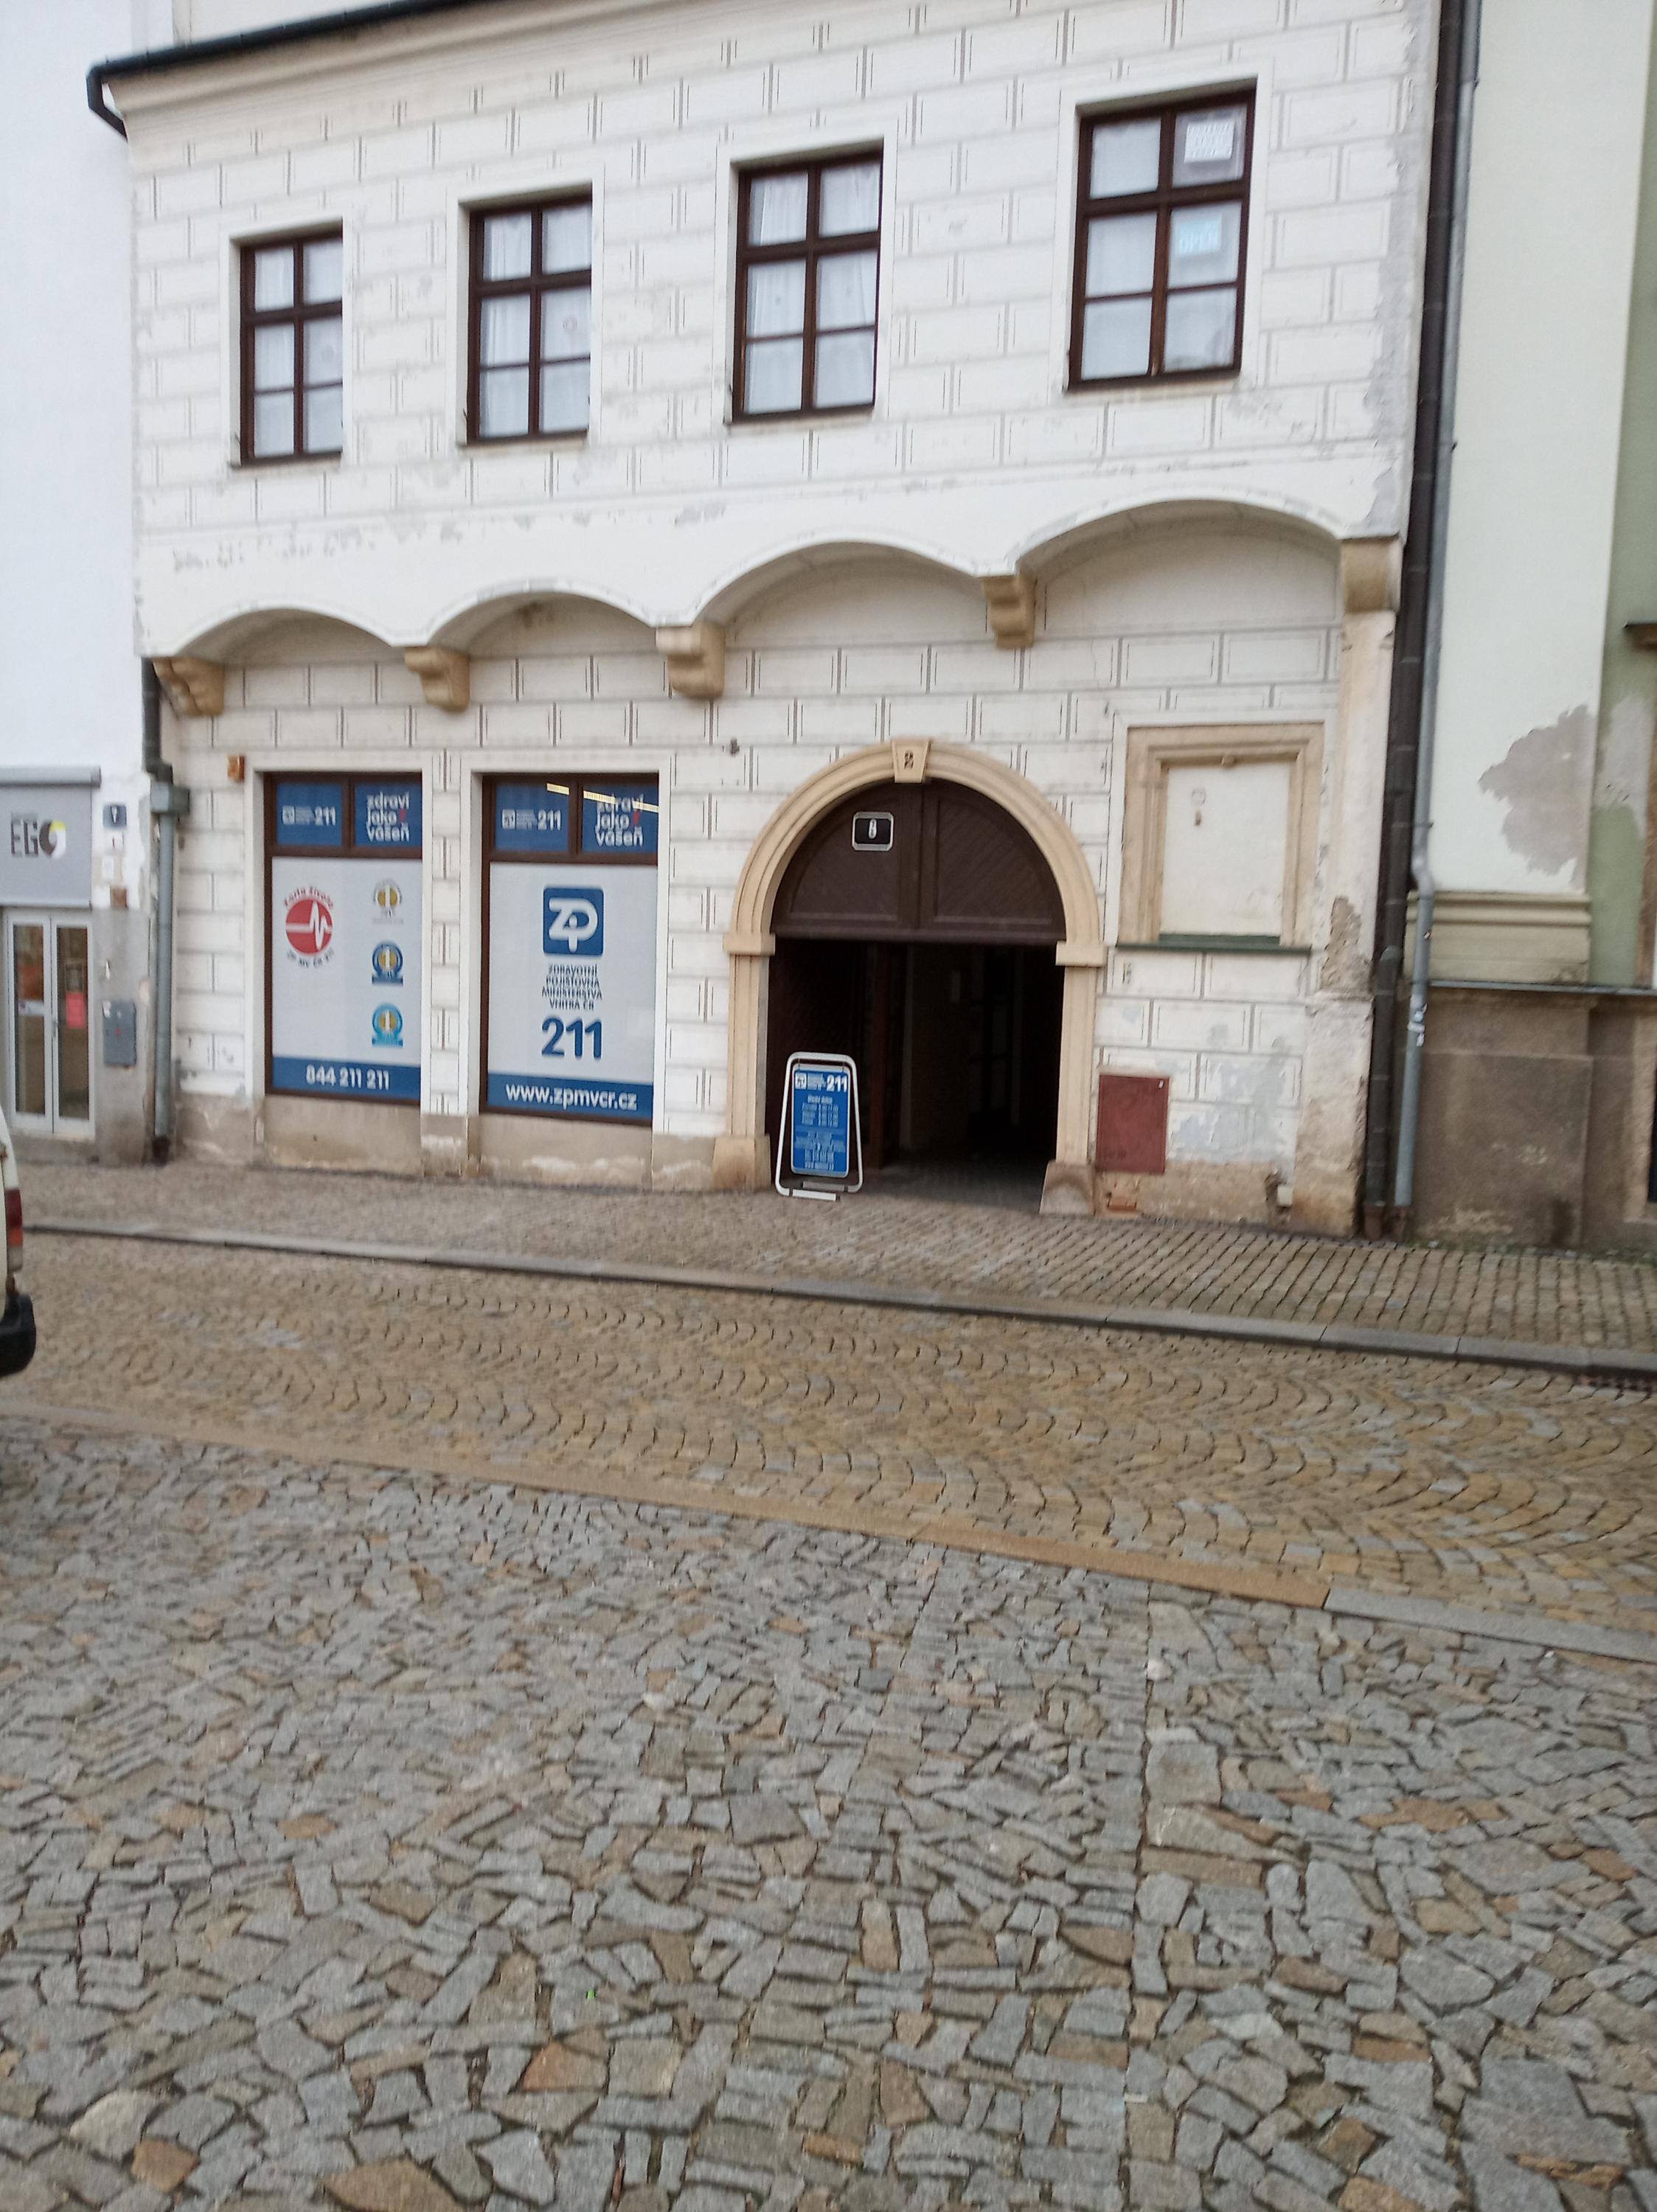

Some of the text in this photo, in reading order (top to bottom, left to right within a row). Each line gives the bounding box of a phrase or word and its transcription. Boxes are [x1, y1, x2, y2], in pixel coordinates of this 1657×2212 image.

[538, 810, 561, 830] 211
[10, 818, 67, 859] EGO
[541, 1016, 602, 1061] 211
[339, 1067, 361, 1088] 211
[367, 1069, 389, 1091] 211
[827, 1074, 847, 1093] 211
[506, 1084, 637, 1110] www.zpmvcr.cz
